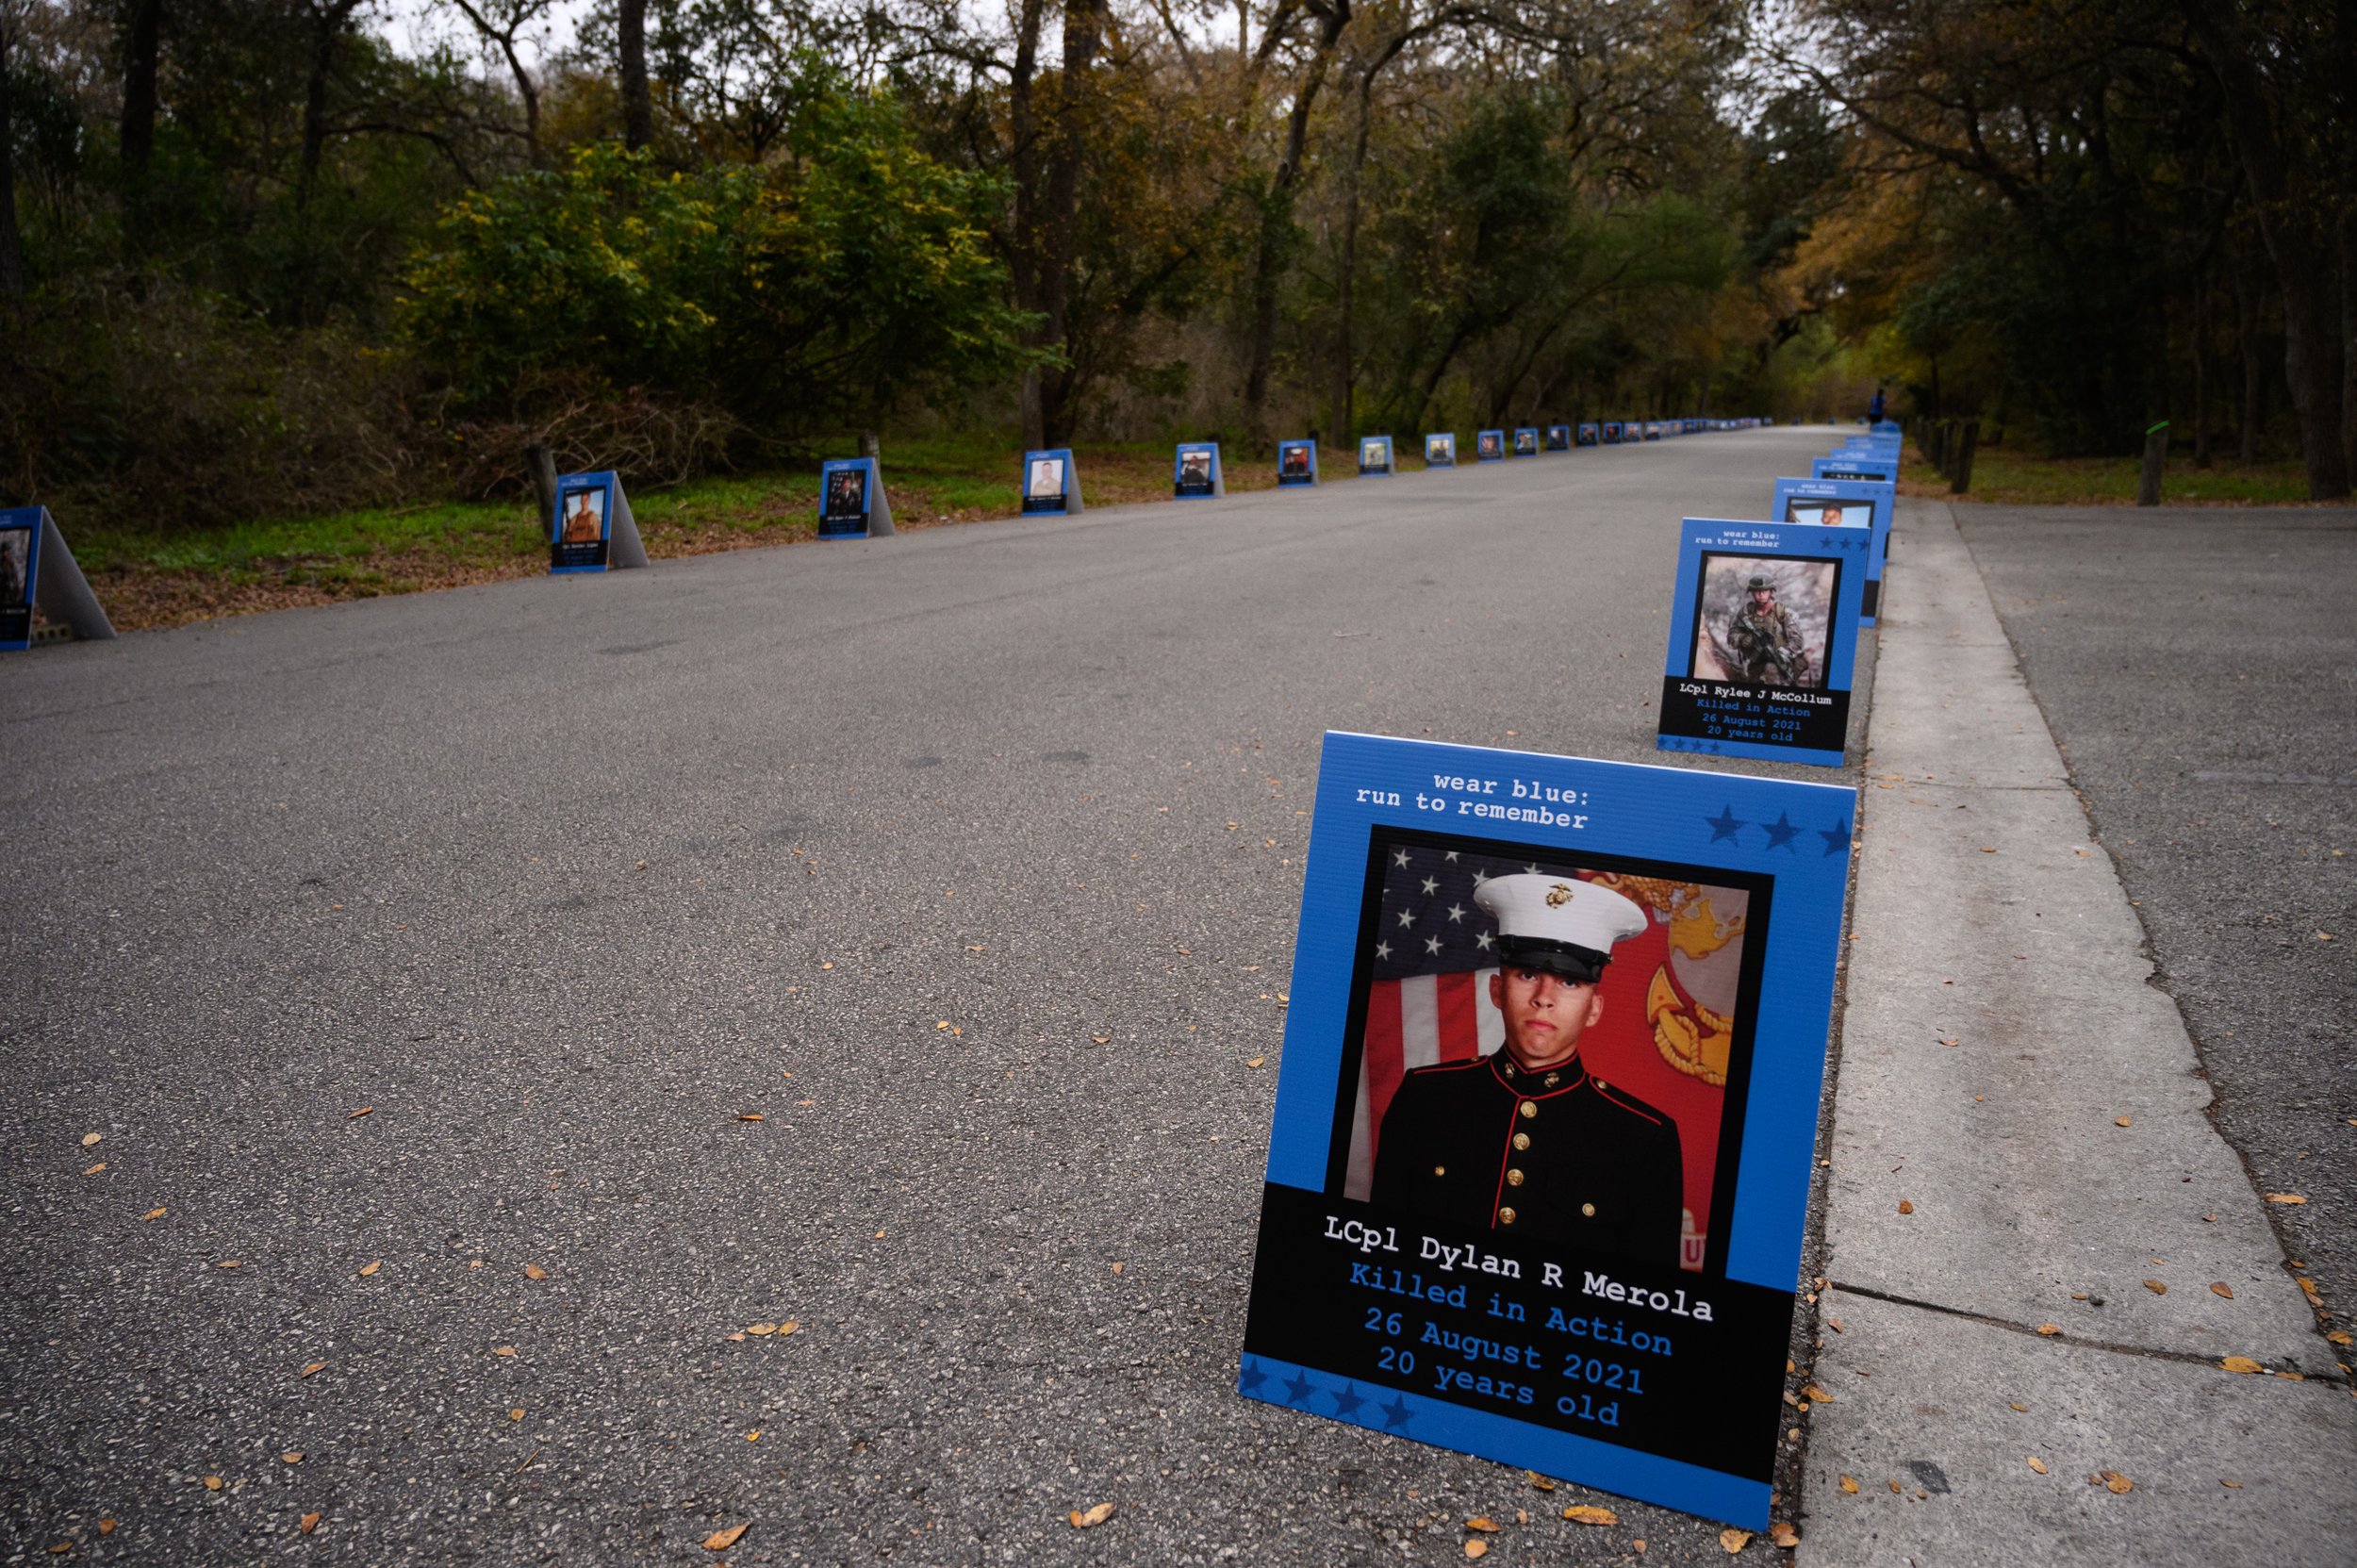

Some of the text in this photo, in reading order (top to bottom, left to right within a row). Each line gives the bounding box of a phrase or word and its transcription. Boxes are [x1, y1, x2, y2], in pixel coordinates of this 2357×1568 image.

[1723, 530, 1780, 539] wear blue:
[1732, 538, 1780, 548] remember
[1679, 683, 1832, 705] LCpl Rylee J McCollum
[1697, 699, 1811, 718] Killed in Action
[1702, 713, 1802, 731] 26 August 2021
[1707, 725, 1793, 742] 20 years old
[1433, 774, 1589, 806] wear blue:
[1356, 788, 1589, 830] run to remember
[1324, 1215, 1714, 1322] LCpl Dylan R Merola
[1349, 1262, 1673, 1357] Killed in Action
[1364, 1307, 1644, 1395] 26 August 2021
[1377, 1345, 1620, 1427] 20 years old
